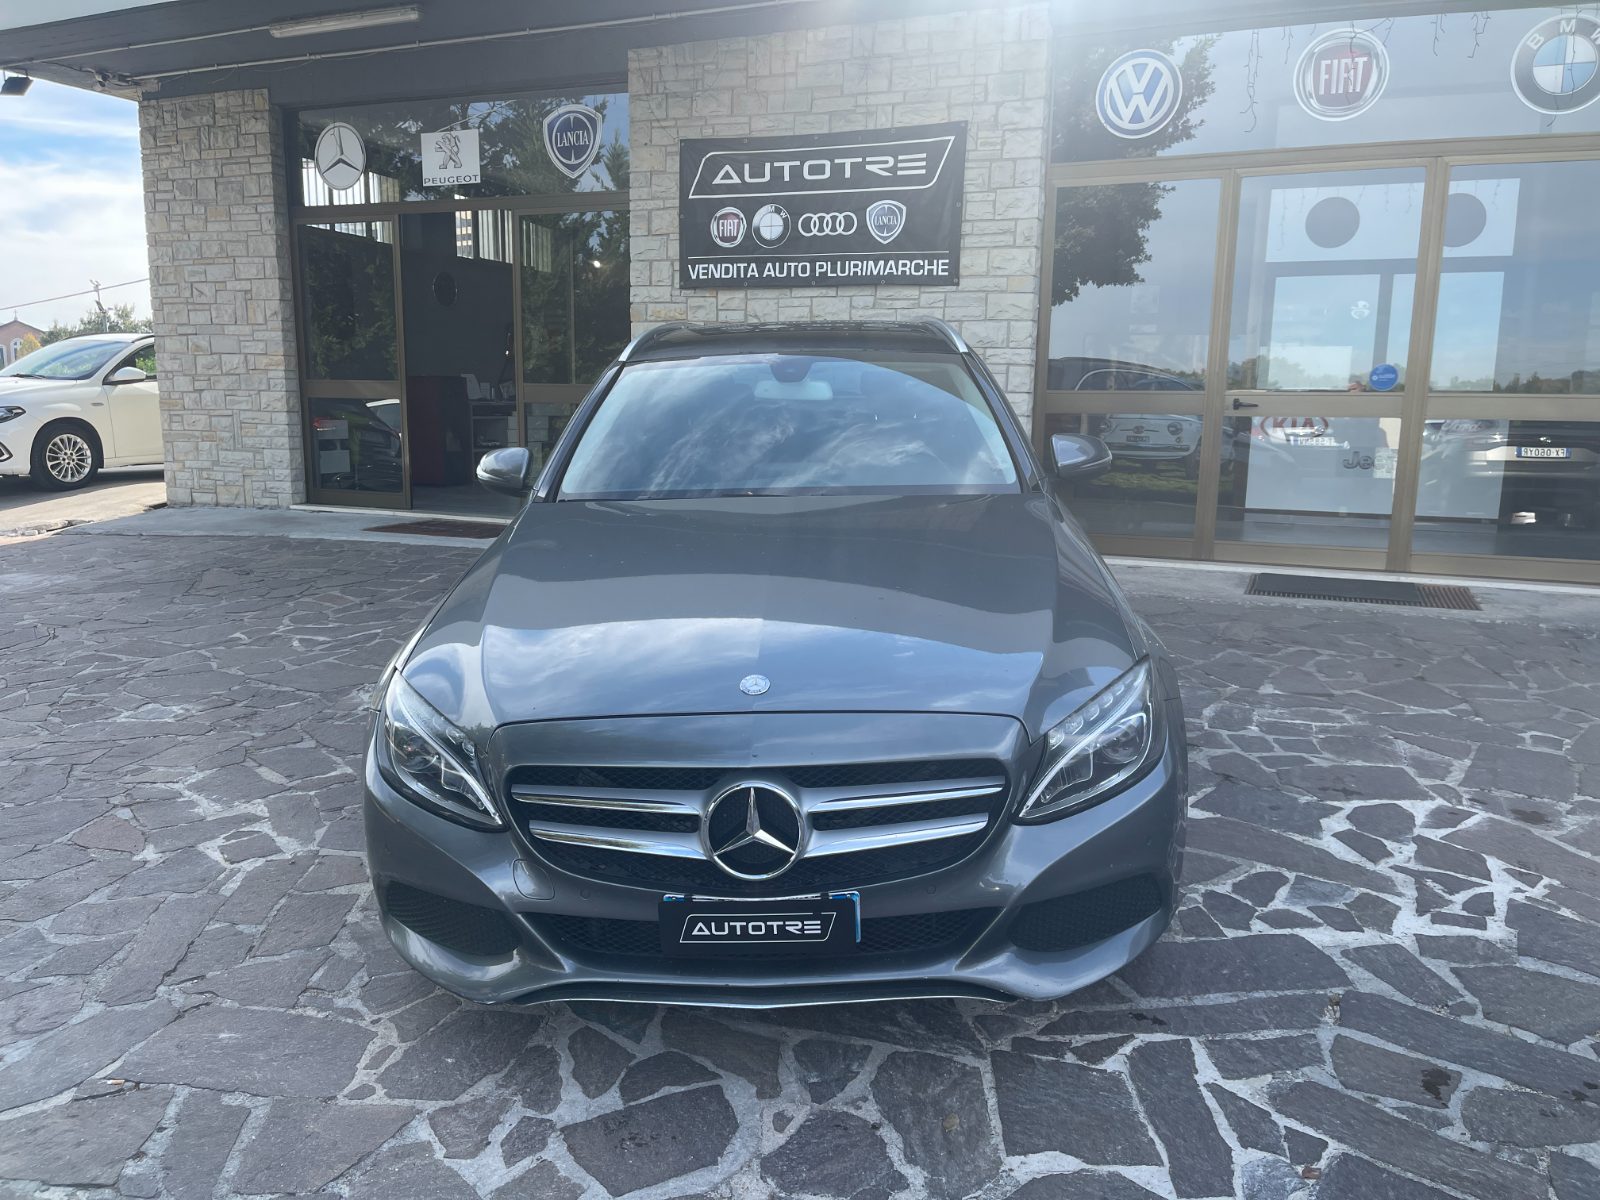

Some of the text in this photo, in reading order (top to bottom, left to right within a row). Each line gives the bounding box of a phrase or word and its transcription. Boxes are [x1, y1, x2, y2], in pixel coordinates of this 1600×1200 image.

[1318, 56, 1369, 96] FIAT
[556, 130, 590, 147] LANCIA
[712, 153, 927, 185] AUTOTRE
[423, 174, 480, 185] PEUGEOT
[719, 219, 739, 237] FIAT
[874, 215, 898, 226] LANCIA
[688, 259, 950, 280] VENDITA AUTO PLURIMARCHE
[692, 920, 821, 936] AUTOTRE
